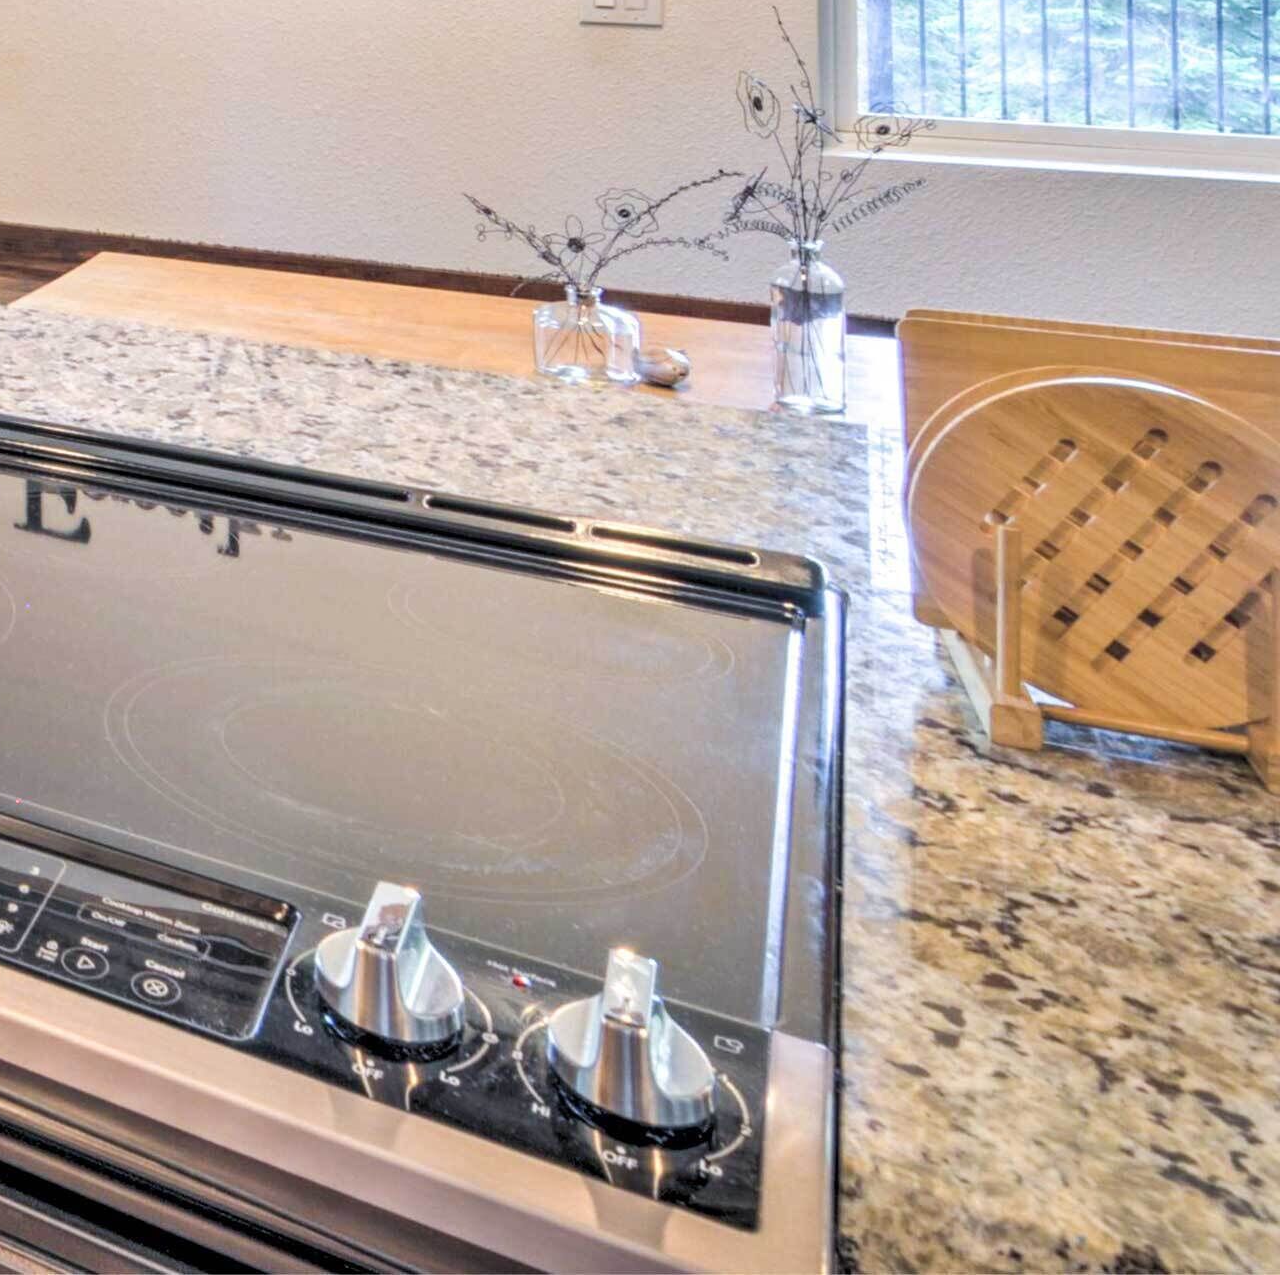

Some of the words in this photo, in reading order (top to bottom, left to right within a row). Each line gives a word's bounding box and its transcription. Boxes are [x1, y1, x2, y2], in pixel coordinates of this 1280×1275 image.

[30, 866, 41, 876] 3
[18, 883, 30, 894] 6
[7, 903, 18, 913] 9
[102, 897, 143, 916] Cooktop
[145, 909, 175, 926] Warm
[91, 911, 127, 927] On/Off
[80, 936, 110, 953] Start
[144, 959, 186, 979] Cancel
[293, 1022, 314, 1036] Lo
[351, 1062, 384, 1080] OFF
[439, 1070, 460, 1087] Lo
[531, 1102, 551, 1118] Hi
[601, 1149, 639, 1170] OFF
[699, 1160, 723, 1178] Lo
